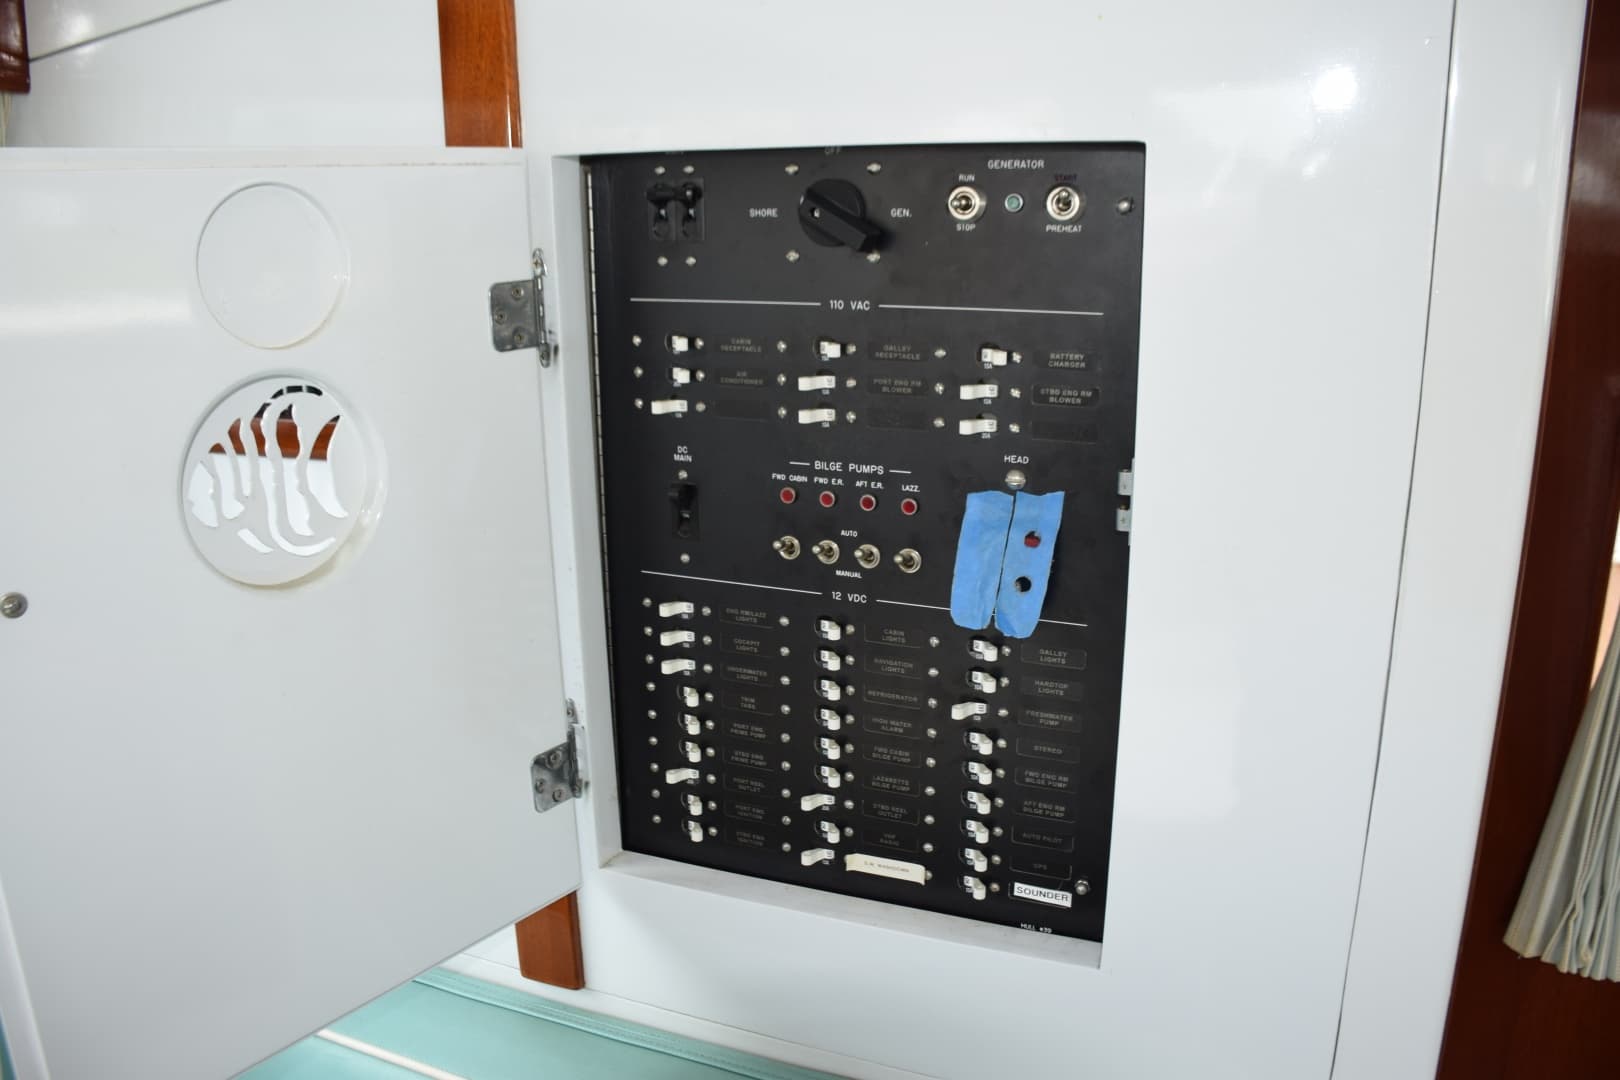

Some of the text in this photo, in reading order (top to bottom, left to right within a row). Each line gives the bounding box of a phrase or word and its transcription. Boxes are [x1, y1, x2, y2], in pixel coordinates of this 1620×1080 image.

[987, 159, 1045, 170] GENERATOR
[957, 173, 976, 183] RUN
[749, 207, 778, 219] SHORE
[890, 207, 912, 219] GEN.
[955, 223, 977, 232] STOP
[1045, 223, 1083, 233] PREHEAT
[828, 299, 871, 311] 110 VAC
[1049, 352, 1086, 361] BATTERY
[1048, 360, 1086, 369] CHARGER
[1048, 396, 1082, 405] BLOWER
[677, 445, 689, 454] DC
[673, 453, 692, 463] MAIN
[1004, 454, 1030, 465] HEAD
[814, 460, 885, 476] BILGE PUMPS
[771, 473, 809, 484] FWD CABIN
[813, 476, 830, 486] FWD
[855, 480, 869, 490] AFT
[840, 529, 859, 538] AUTO
[835, 570, 864, 580] MANUAL
[832, 591, 868, 605] 12 VDC
[1040, 649, 1067, 657] GALLEY
[1040, 657, 1066, 665] LIGHTS
[1035, 681, 1069, 689] HARDTOP
[1039, 688, 1065, 696] LIGHTS
[1026, 710, 1073, 721] FRESHWATER
[1033, 745, 1063, 755] STEREO
[1015, 885, 1069, 903] SOUNDER
